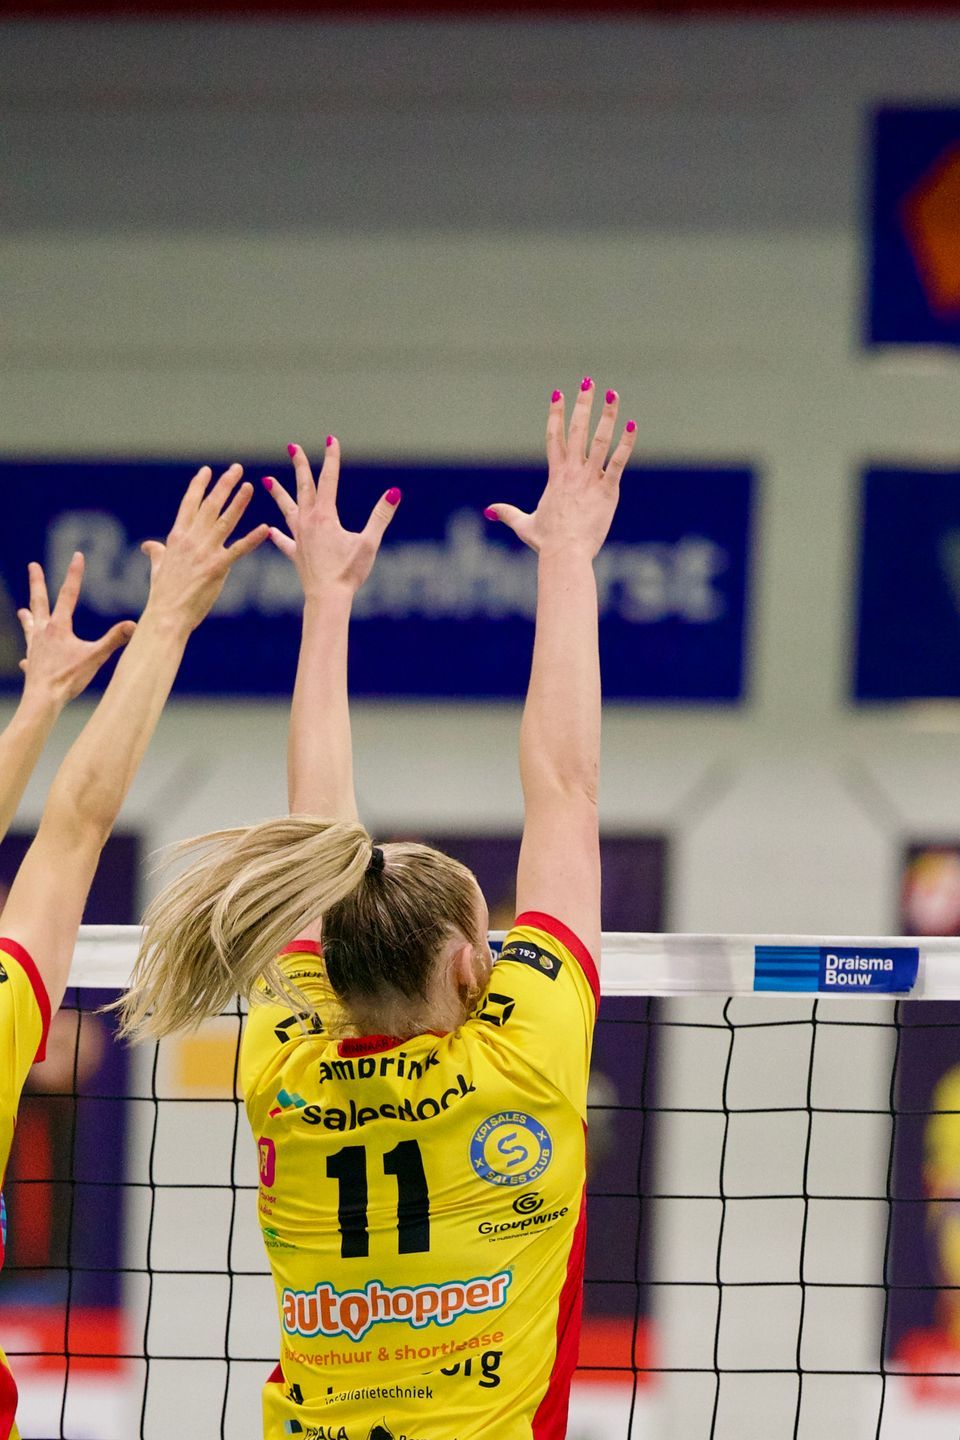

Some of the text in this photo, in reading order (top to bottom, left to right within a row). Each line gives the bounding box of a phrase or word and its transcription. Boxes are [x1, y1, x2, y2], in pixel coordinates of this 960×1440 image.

[825, 955, 894, 971] Draisma
[825, 970, 872, 986] Bouw
[474, 1113, 527, 1143] KPI SALES
[486, 1148, 550, 1185] SALES CLUB
[326, 1139, 431, 1259] 11
[478, 1206, 569, 1235] Groupwise
[283, 1274, 508, 1338] autohopper
[378, 1347, 390, 1361] &
